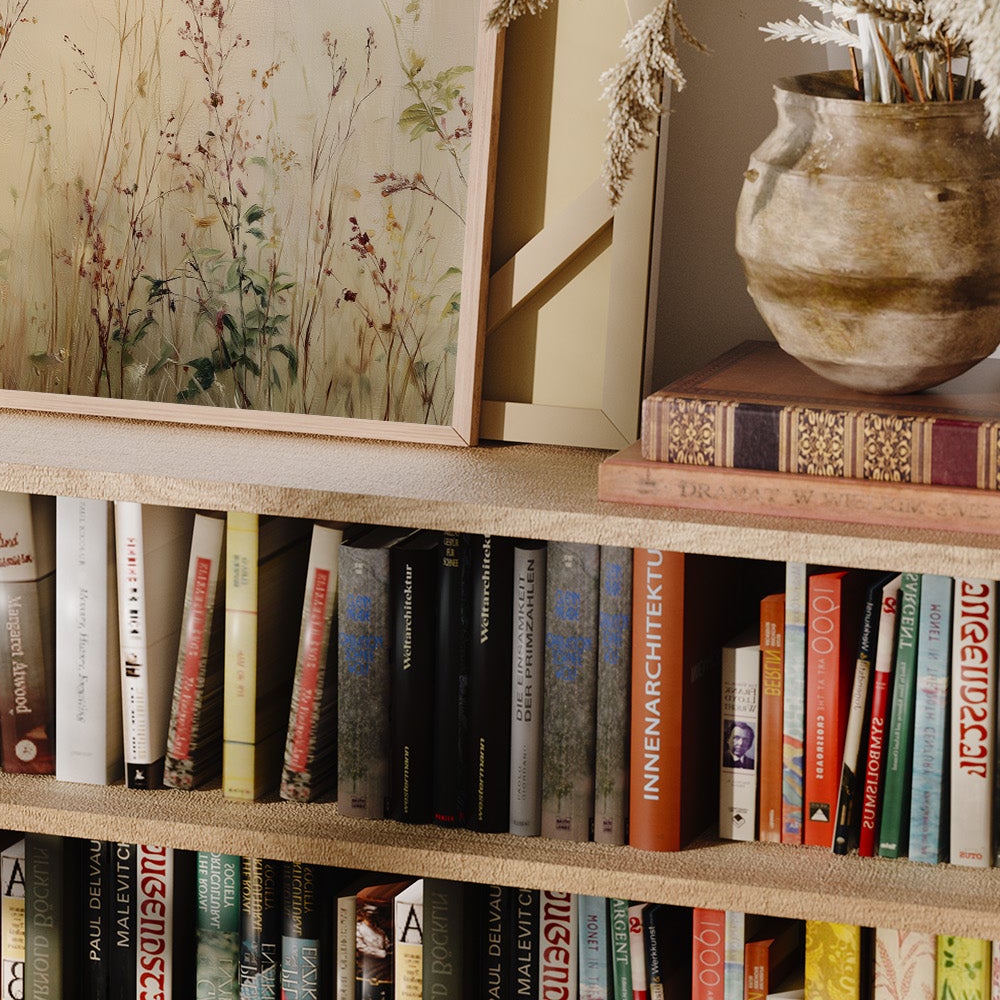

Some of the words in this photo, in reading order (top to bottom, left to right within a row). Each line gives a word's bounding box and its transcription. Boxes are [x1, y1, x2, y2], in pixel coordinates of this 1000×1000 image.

[792, 488, 815, 506] W
[6, 595, 23, 656] Margaret
[404, 564, 412, 670] Weltarchitektur
[517, 576, 526, 695] EINSAMKEIT
[526, 558, 534, 679] PRIMZAHLEN
[12, 660, 32, 714] Atwood
[524, 682, 532, 722] DER
[478, 738, 486, 821] westermann
[90, 917, 101, 960] PAUL
[588, 914, 598, 952] MONET
[628, 916, 643, 935] 2
[650, 925, 660, 971] Werkkunst
[588, 959, 598, 972] IN
[698, 920, 721, 988] 1900
